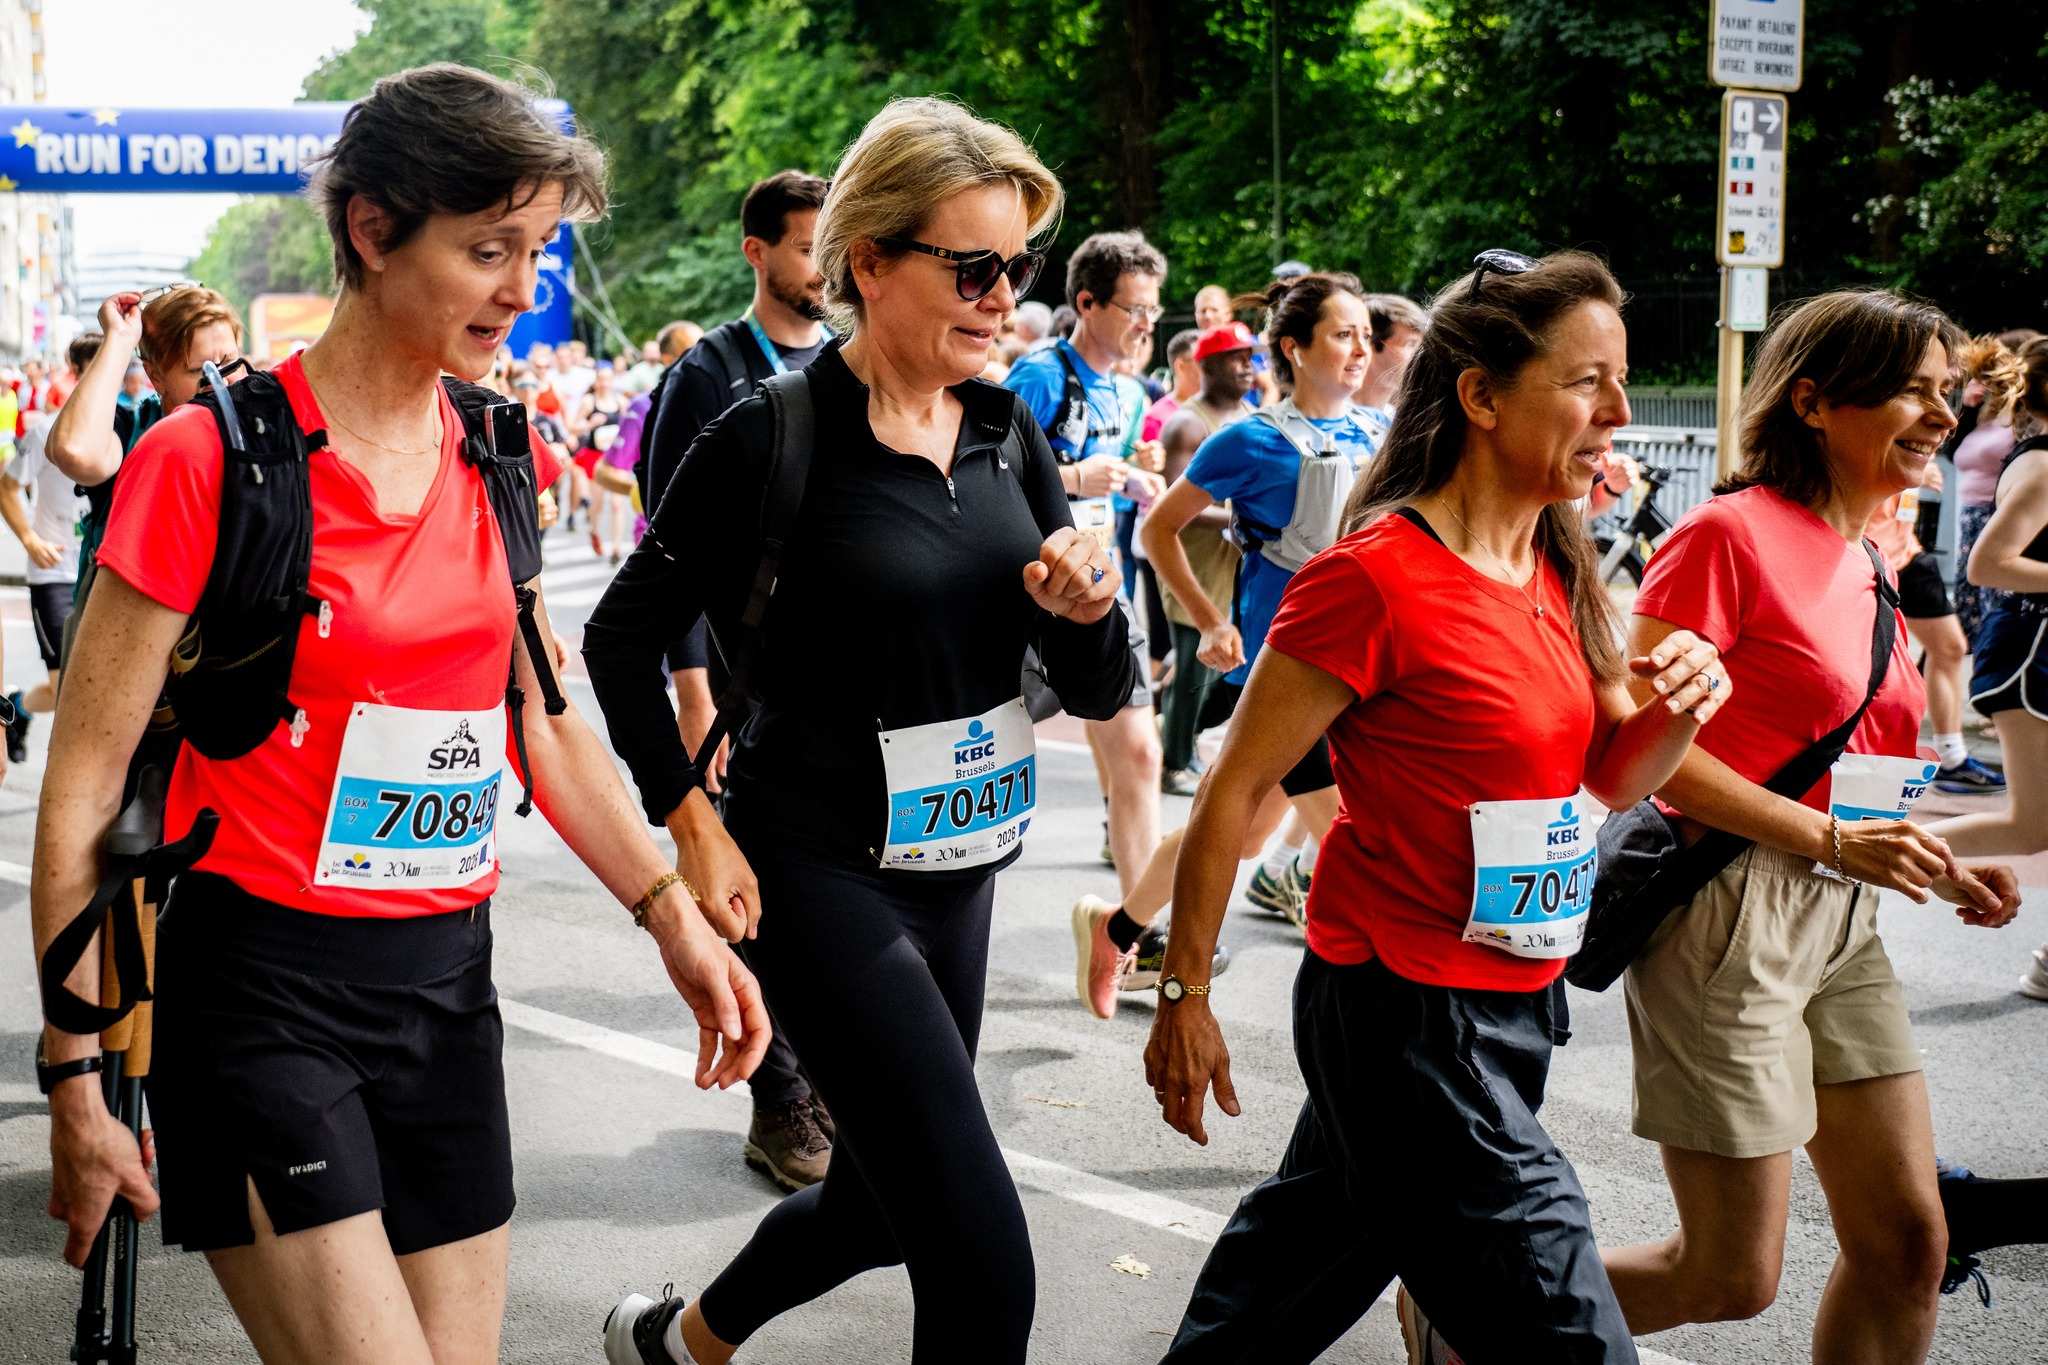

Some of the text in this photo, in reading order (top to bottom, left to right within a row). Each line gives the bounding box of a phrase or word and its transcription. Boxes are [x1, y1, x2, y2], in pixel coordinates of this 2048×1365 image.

[36, 134, 121, 175] RUN
[128, 134, 207, 175] FOR
[427, 747, 481, 770] SPA
[955, 742, 995, 764] KBC
[955, 761, 995, 779] Brussels
[344, 797, 368, 809] BOX
[373, 780, 499, 840] 70849
[922, 765, 1030, 835] 70471
[997, 826, 1016, 848] 2026
[1547, 826, 1579, 845] KBC
